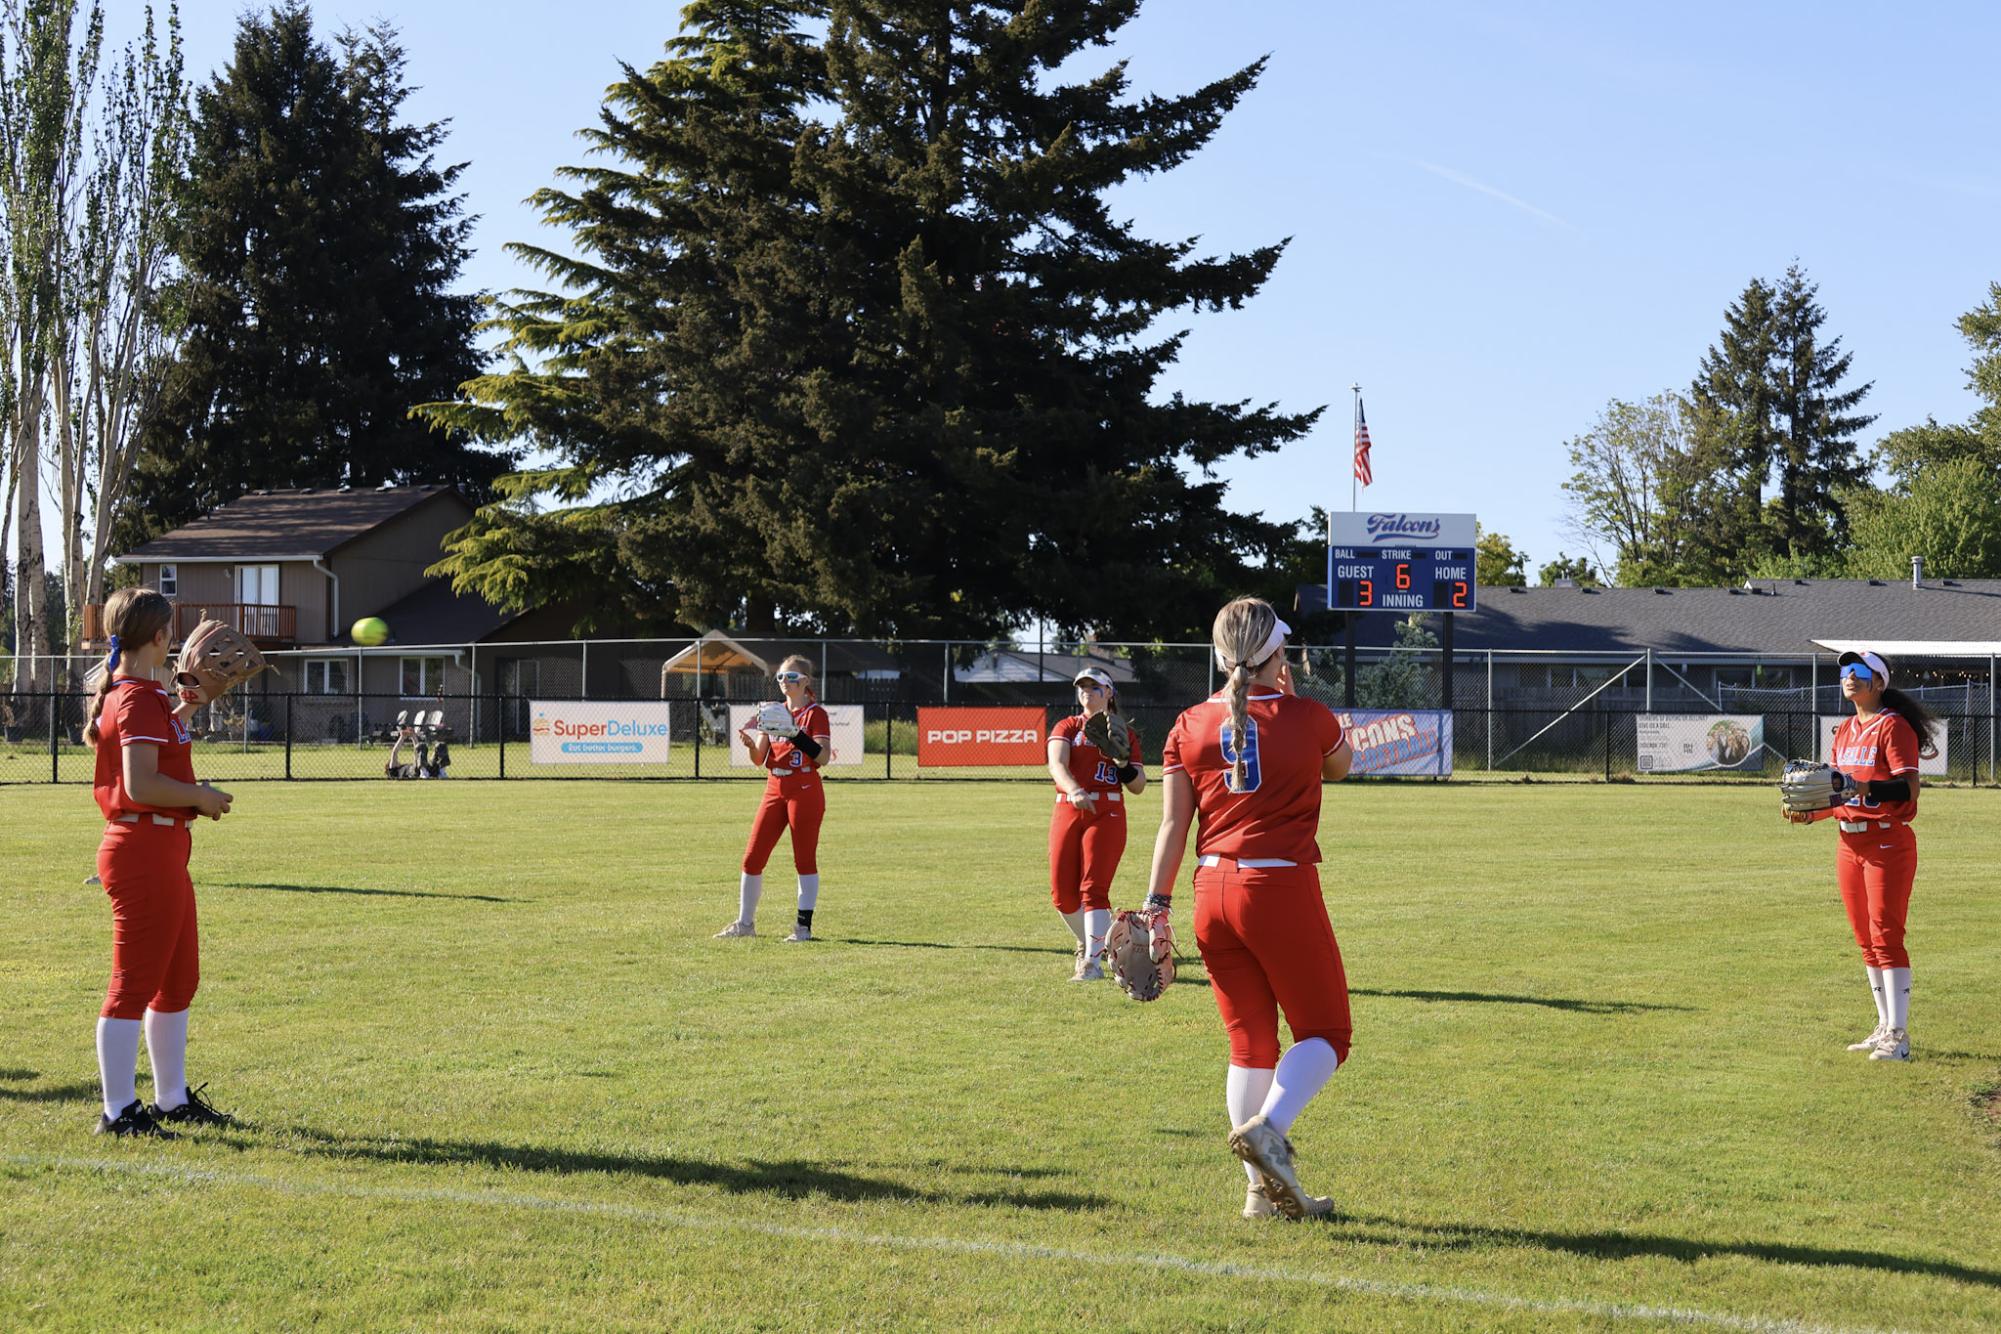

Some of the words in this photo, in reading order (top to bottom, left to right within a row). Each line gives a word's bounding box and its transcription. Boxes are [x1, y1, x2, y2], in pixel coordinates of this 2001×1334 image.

[1367, 513, 1441, 542] Falcons
[1334, 549, 1355, 559] BALL
[1381, 549, 1412, 560] STRIKE
[1435, 550, 1453, 561] OUT
[1337, 565, 1374, 578] GUEST
[1395, 563, 1411, 589] 6
[1435, 566, 1467, 580] HOME
[1359, 580, 1373, 606] 3
[1382, 594, 1424, 608] INNING
[1452, 581, 1468, 608] 2
[553, 719, 668, 740] SuperDeluxe
[1338, 712, 1353, 729] LE
[927, 729, 972, 744] POP
[976, 729, 1038, 744] PIZZA
[1346, 714, 1416, 753] CONS
[789, 749, 803, 768] 3
[1220, 714, 1262, 793] 9
[1094, 761, 1118, 785] 13
